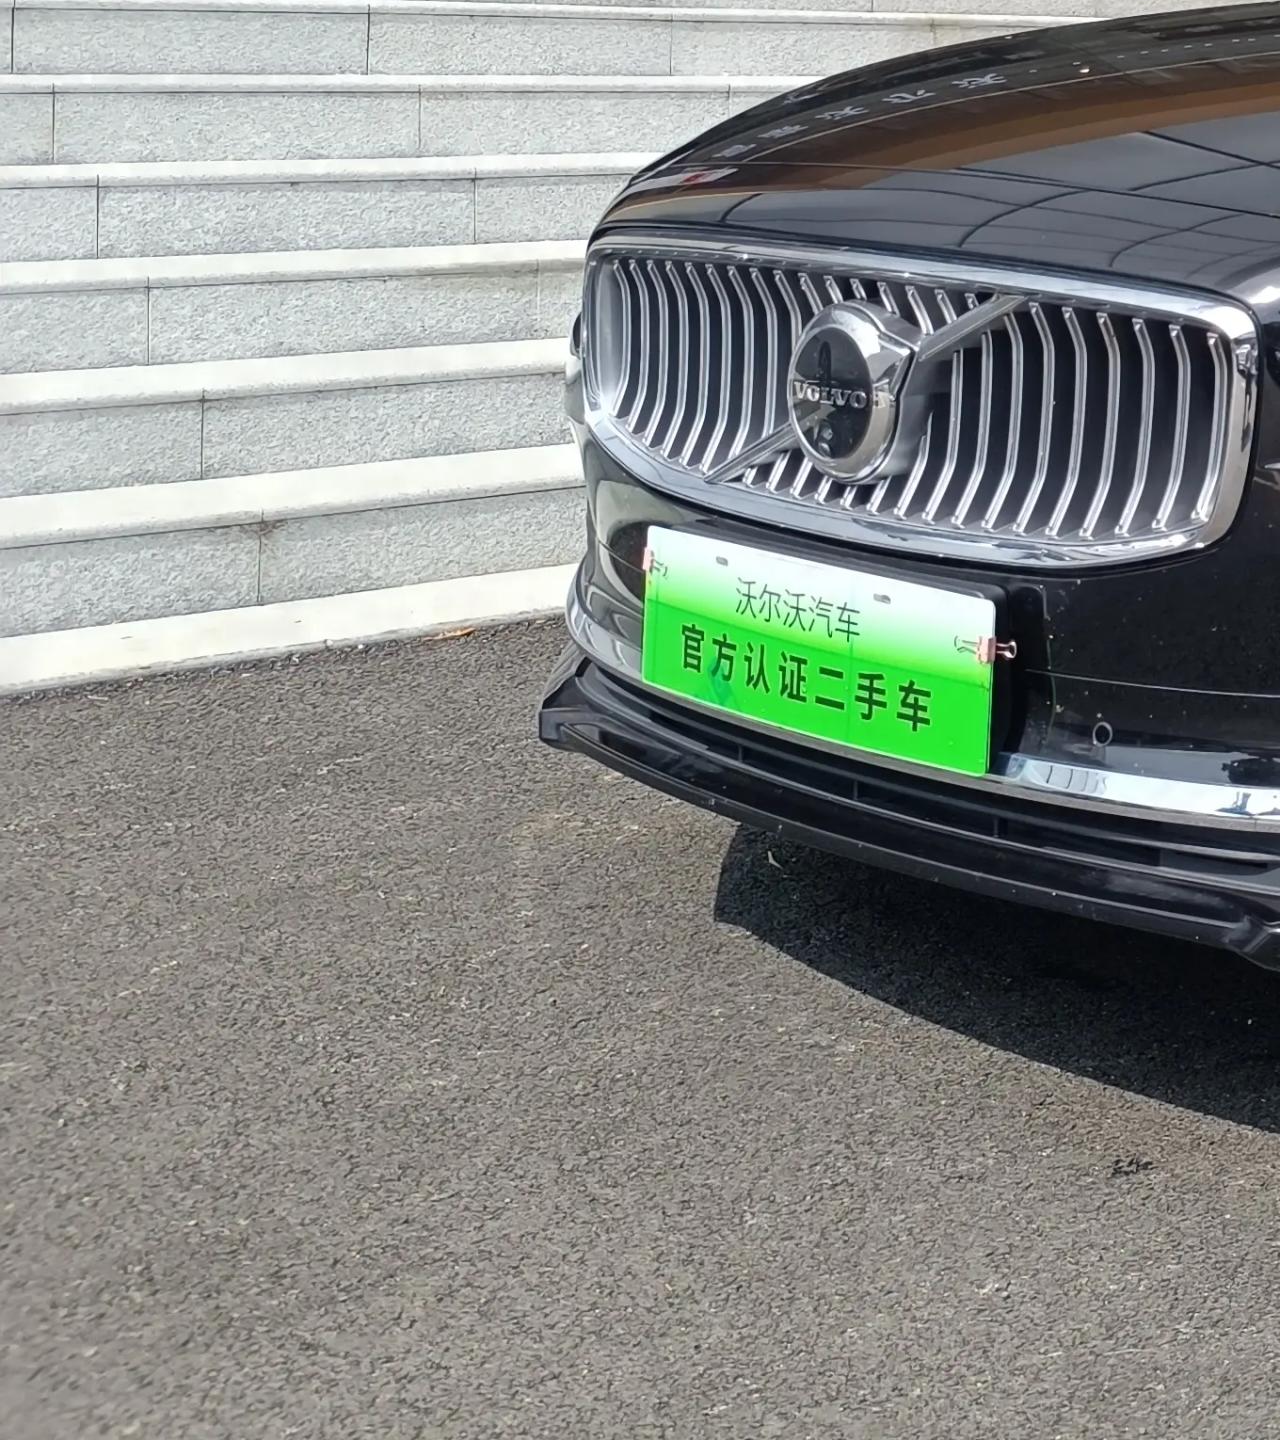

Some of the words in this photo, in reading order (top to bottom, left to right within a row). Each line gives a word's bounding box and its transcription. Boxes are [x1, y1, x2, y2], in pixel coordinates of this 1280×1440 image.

[793, 381, 867, 409] VOLVO
[735, 577, 860, 643] 沃尔沃汽车
[682, 624, 931, 732] 官方认证二手车
